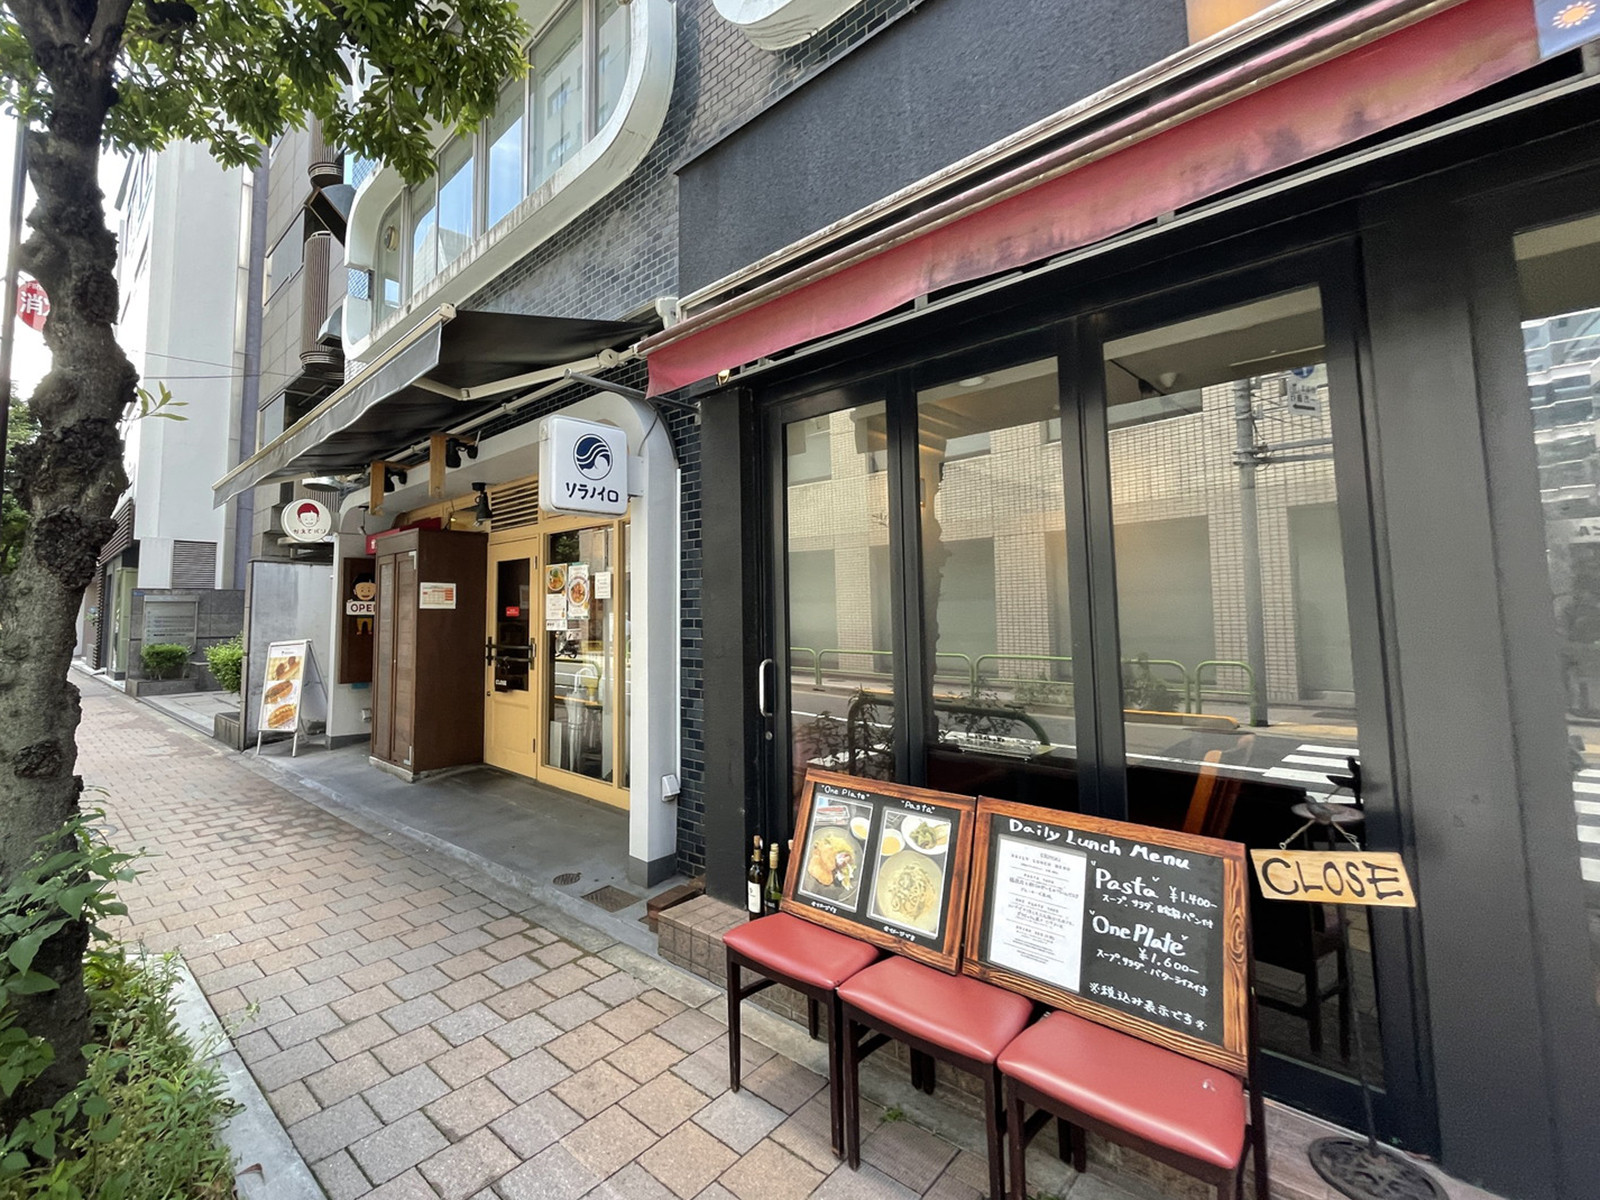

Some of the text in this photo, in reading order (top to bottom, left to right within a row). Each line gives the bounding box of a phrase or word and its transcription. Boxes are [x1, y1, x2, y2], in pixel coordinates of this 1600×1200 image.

[566, 482, 619, 503] ソラノイロ
[350, 603, 376, 612] OPE
[1009, 818, 1190, 870] Daily Lunch Menu
[1262, 857, 1405, 898] CLOSE
